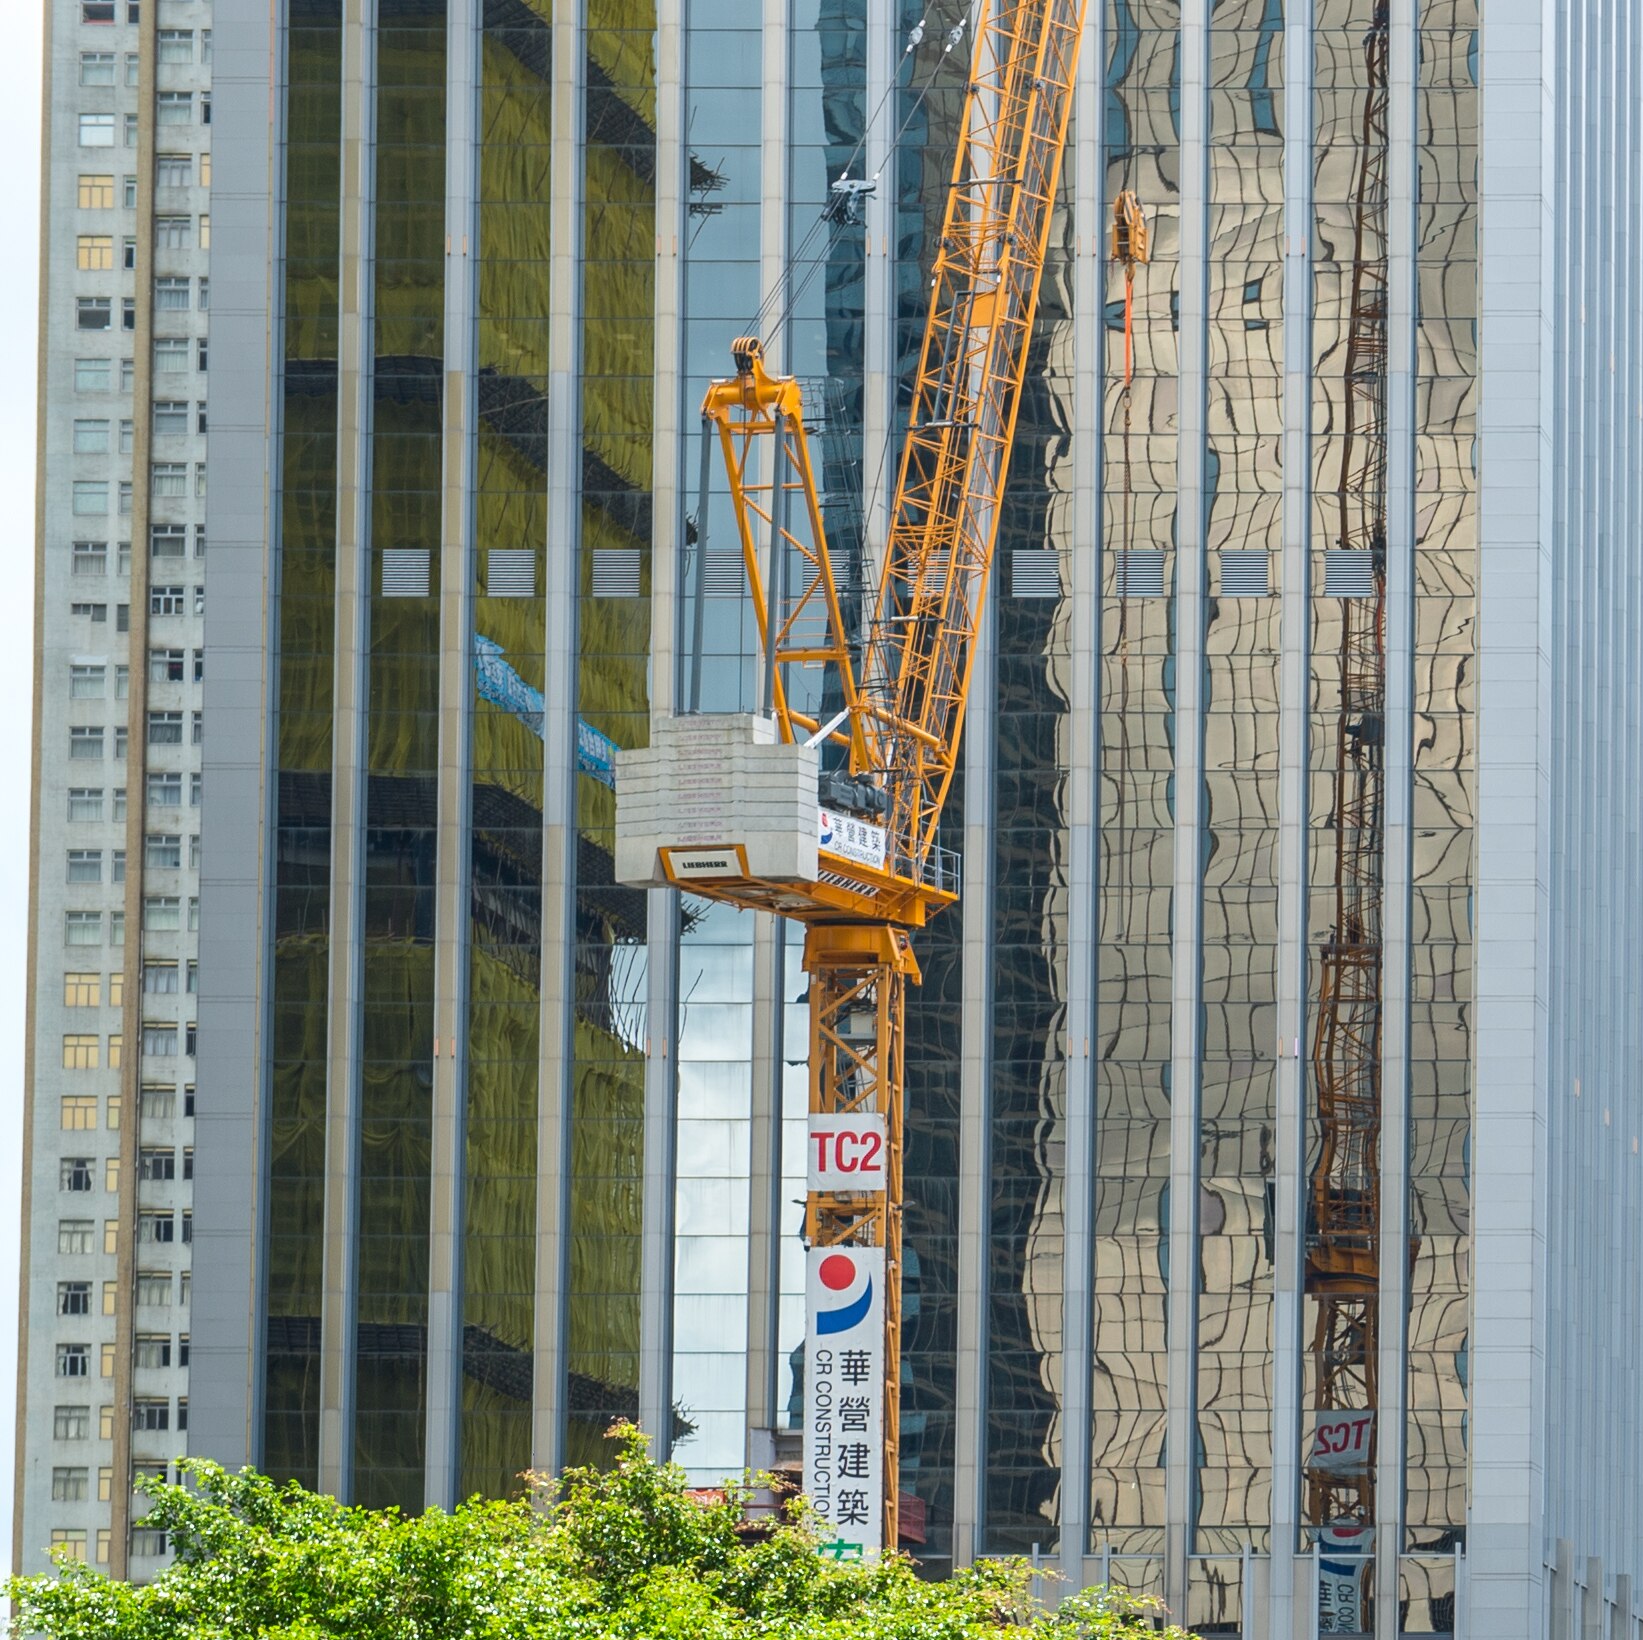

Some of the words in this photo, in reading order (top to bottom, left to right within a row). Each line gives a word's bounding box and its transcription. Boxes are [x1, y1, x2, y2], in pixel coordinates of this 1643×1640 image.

[810, 1131, 882, 1173] TC2
[815, 1349, 832, 1377] CR
[836, 1349, 872, 1526] 華營建築
